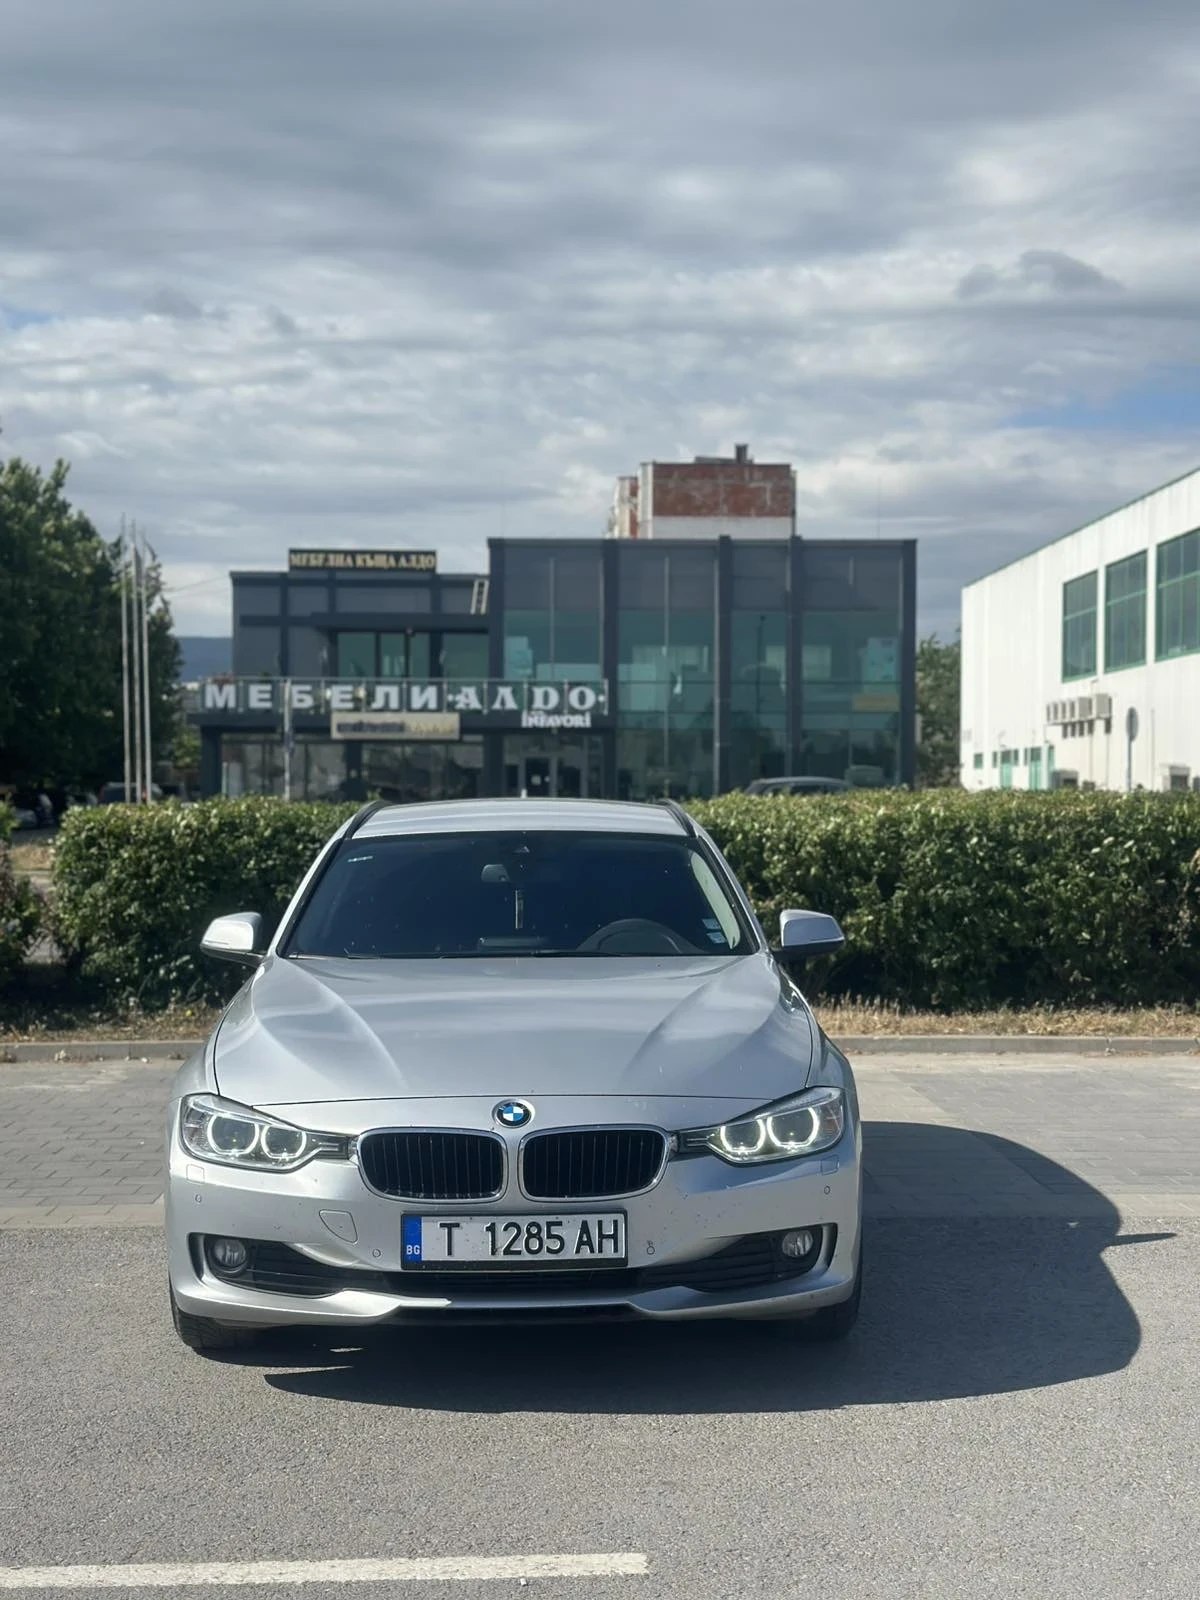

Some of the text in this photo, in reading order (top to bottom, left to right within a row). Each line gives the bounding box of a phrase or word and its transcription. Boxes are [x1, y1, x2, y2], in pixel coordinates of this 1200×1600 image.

[204, 683, 438, 710] МЕБЕЛИ
[406, 1219, 619, 1257] BG T 1285 AH
